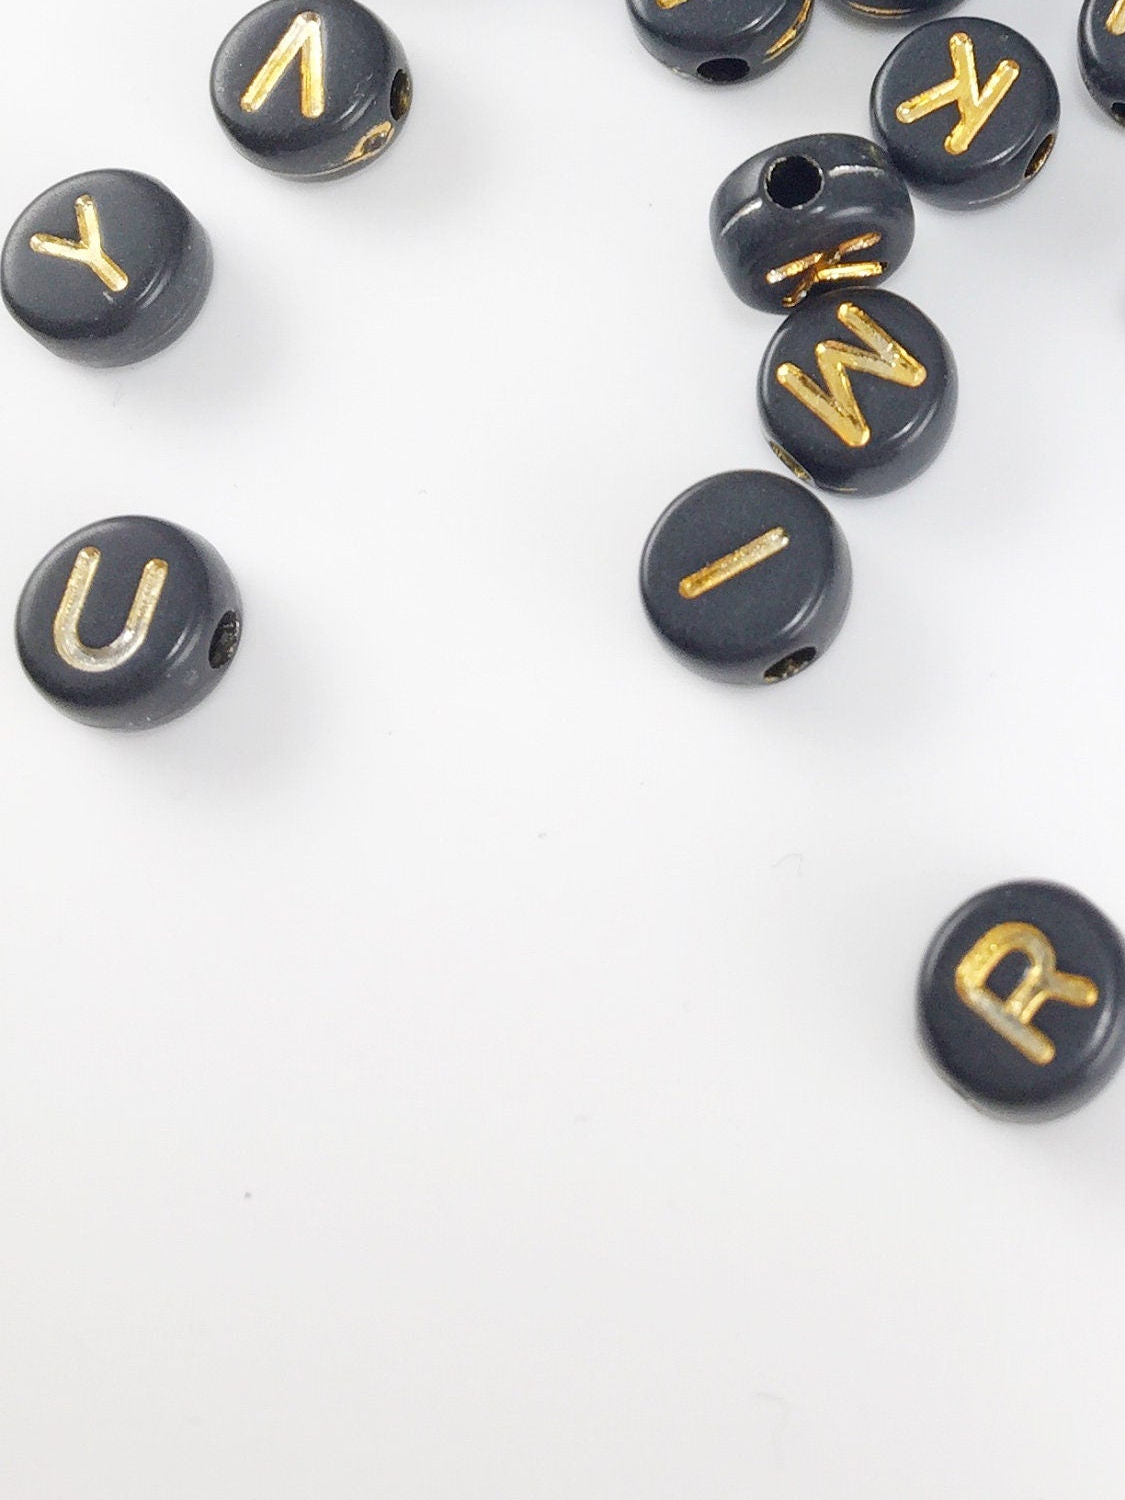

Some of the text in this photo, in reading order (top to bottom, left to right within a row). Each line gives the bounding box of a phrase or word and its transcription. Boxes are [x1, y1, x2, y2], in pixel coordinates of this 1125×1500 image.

[896, 33, 1019, 154] K
[31, 196, 128, 291] Y
[53, 548, 167, 667] U
[956, 923, 1098, 1064] R
